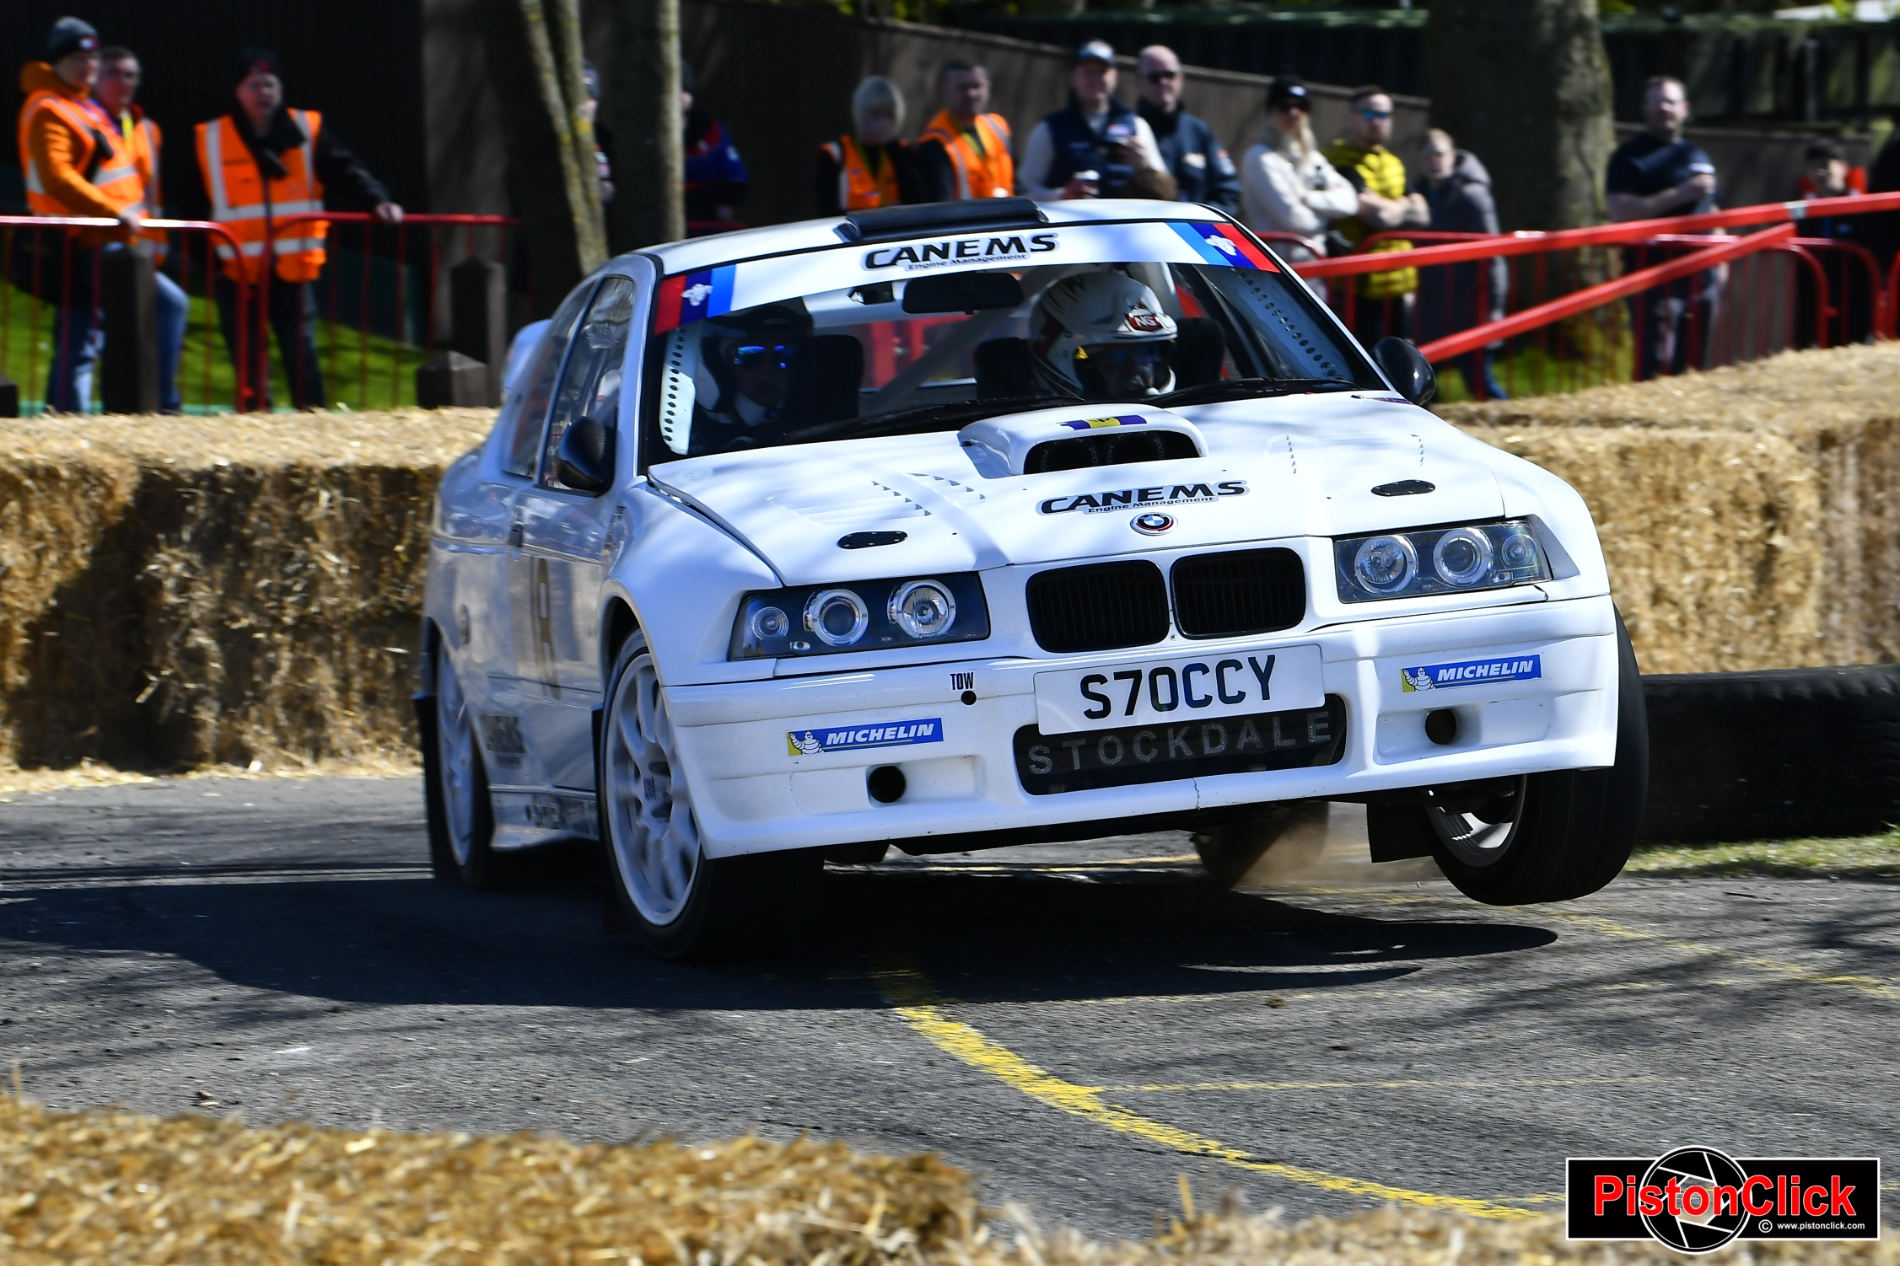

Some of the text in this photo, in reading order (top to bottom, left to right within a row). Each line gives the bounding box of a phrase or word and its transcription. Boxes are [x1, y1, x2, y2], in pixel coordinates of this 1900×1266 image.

[865, 234, 1056, 269] CANEMS
[1041, 481, 1245, 514] CANEMS
[1089, 496, 1215, 514] Engine Management
[950, 672, 974, 691] TOW
[1437, 660, 1534, 682] MICHELIN
[826, 723, 935, 746] MICHELIN
[1029, 711, 1331, 775] STOCKDALE
